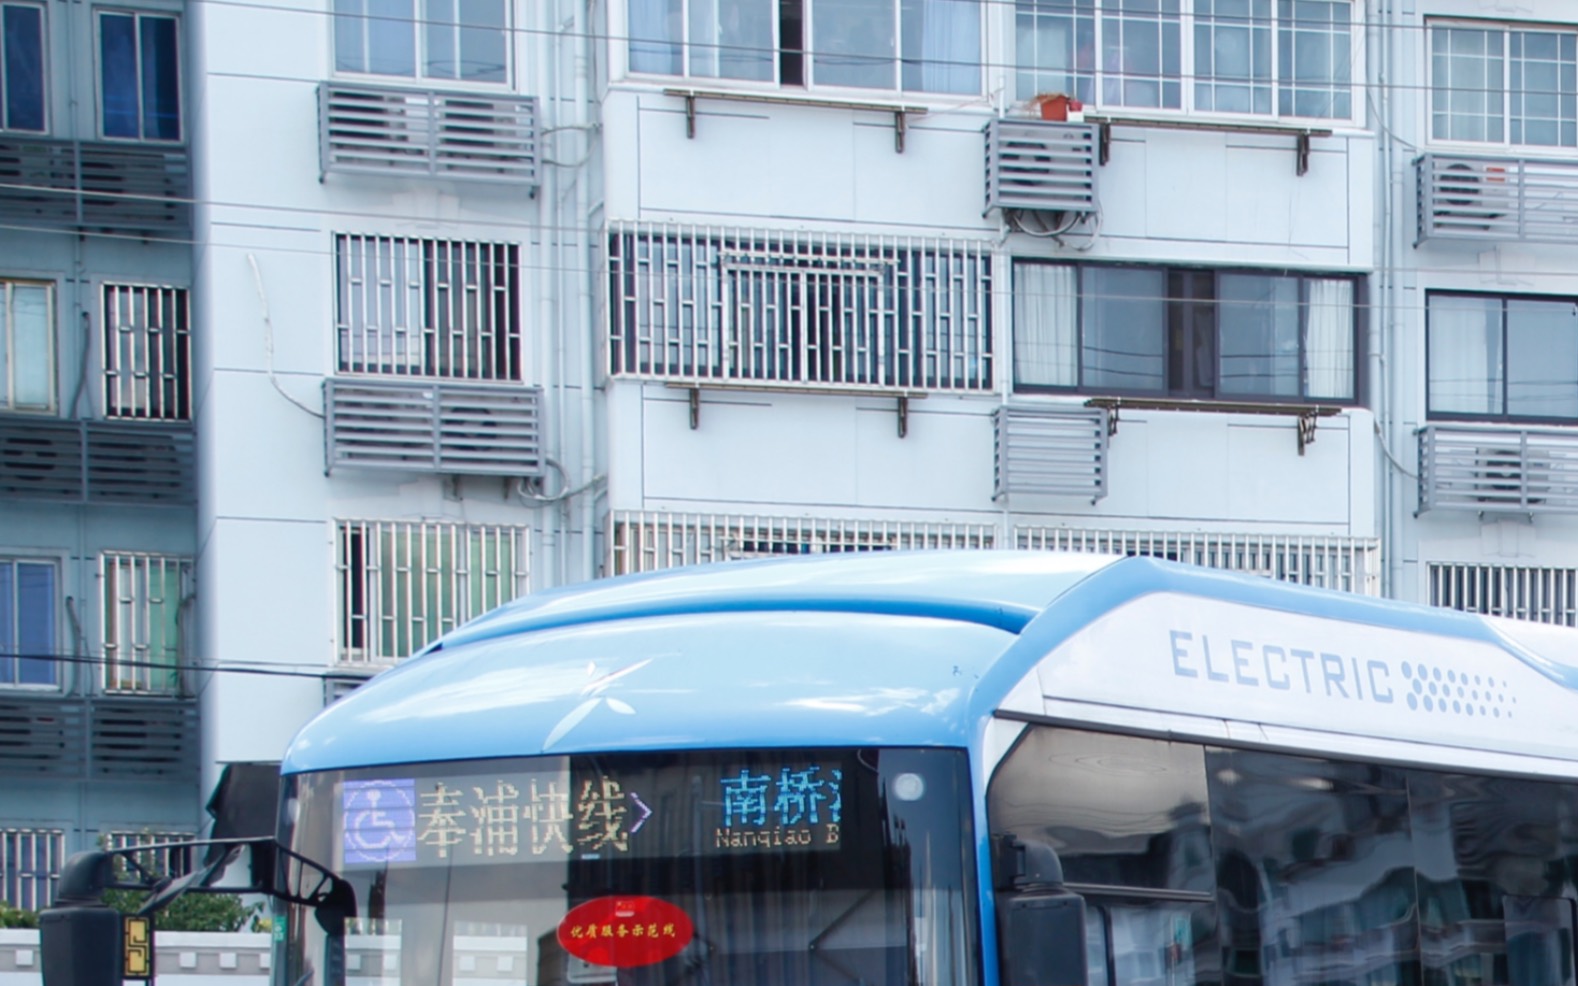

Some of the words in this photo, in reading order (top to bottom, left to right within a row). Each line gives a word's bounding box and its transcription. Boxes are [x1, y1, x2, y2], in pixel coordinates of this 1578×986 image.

[1168, 629, 1394, 704] ELECTRIC
[417, 776, 629, 858] 奉浦快线
[716, 825, 812, 848] Nanqiao
